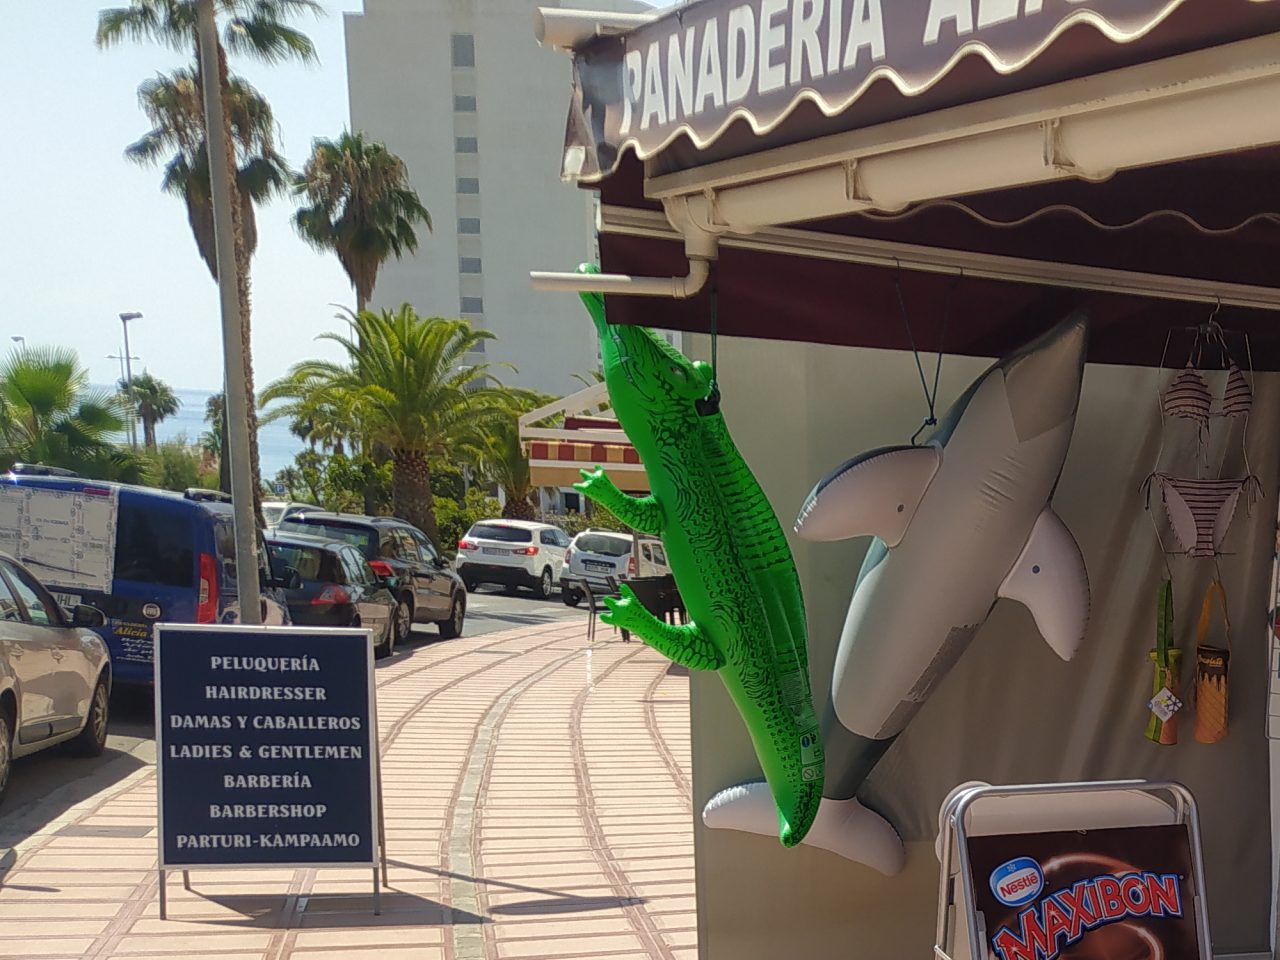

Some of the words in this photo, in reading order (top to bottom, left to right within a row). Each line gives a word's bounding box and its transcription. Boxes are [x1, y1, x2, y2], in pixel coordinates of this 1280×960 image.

[619, 0, 886, 136] PANADERIA
[210, 655, 320, 673] PELUQUERÍA
[205, 685, 327, 701] HAIRDRESSER
[170, 714, 232, 729] DAMAS
[237, 715, 248, 729] Y
[252, 715, 361, 730] CABALLEROS
[170, 744, 233, 759] LADIES
[239, 745, 253, 759] &
[258, 745, 363, 759] GENTLEMEN
[223, 771, 312, 788] BARBERÍA
[209, 804, 328, 818] BARBERSHOP
[176, 833, 360, 849] PARTURI-KAMPAAMO
[1000, 872, 1039, 898] Nestlé
